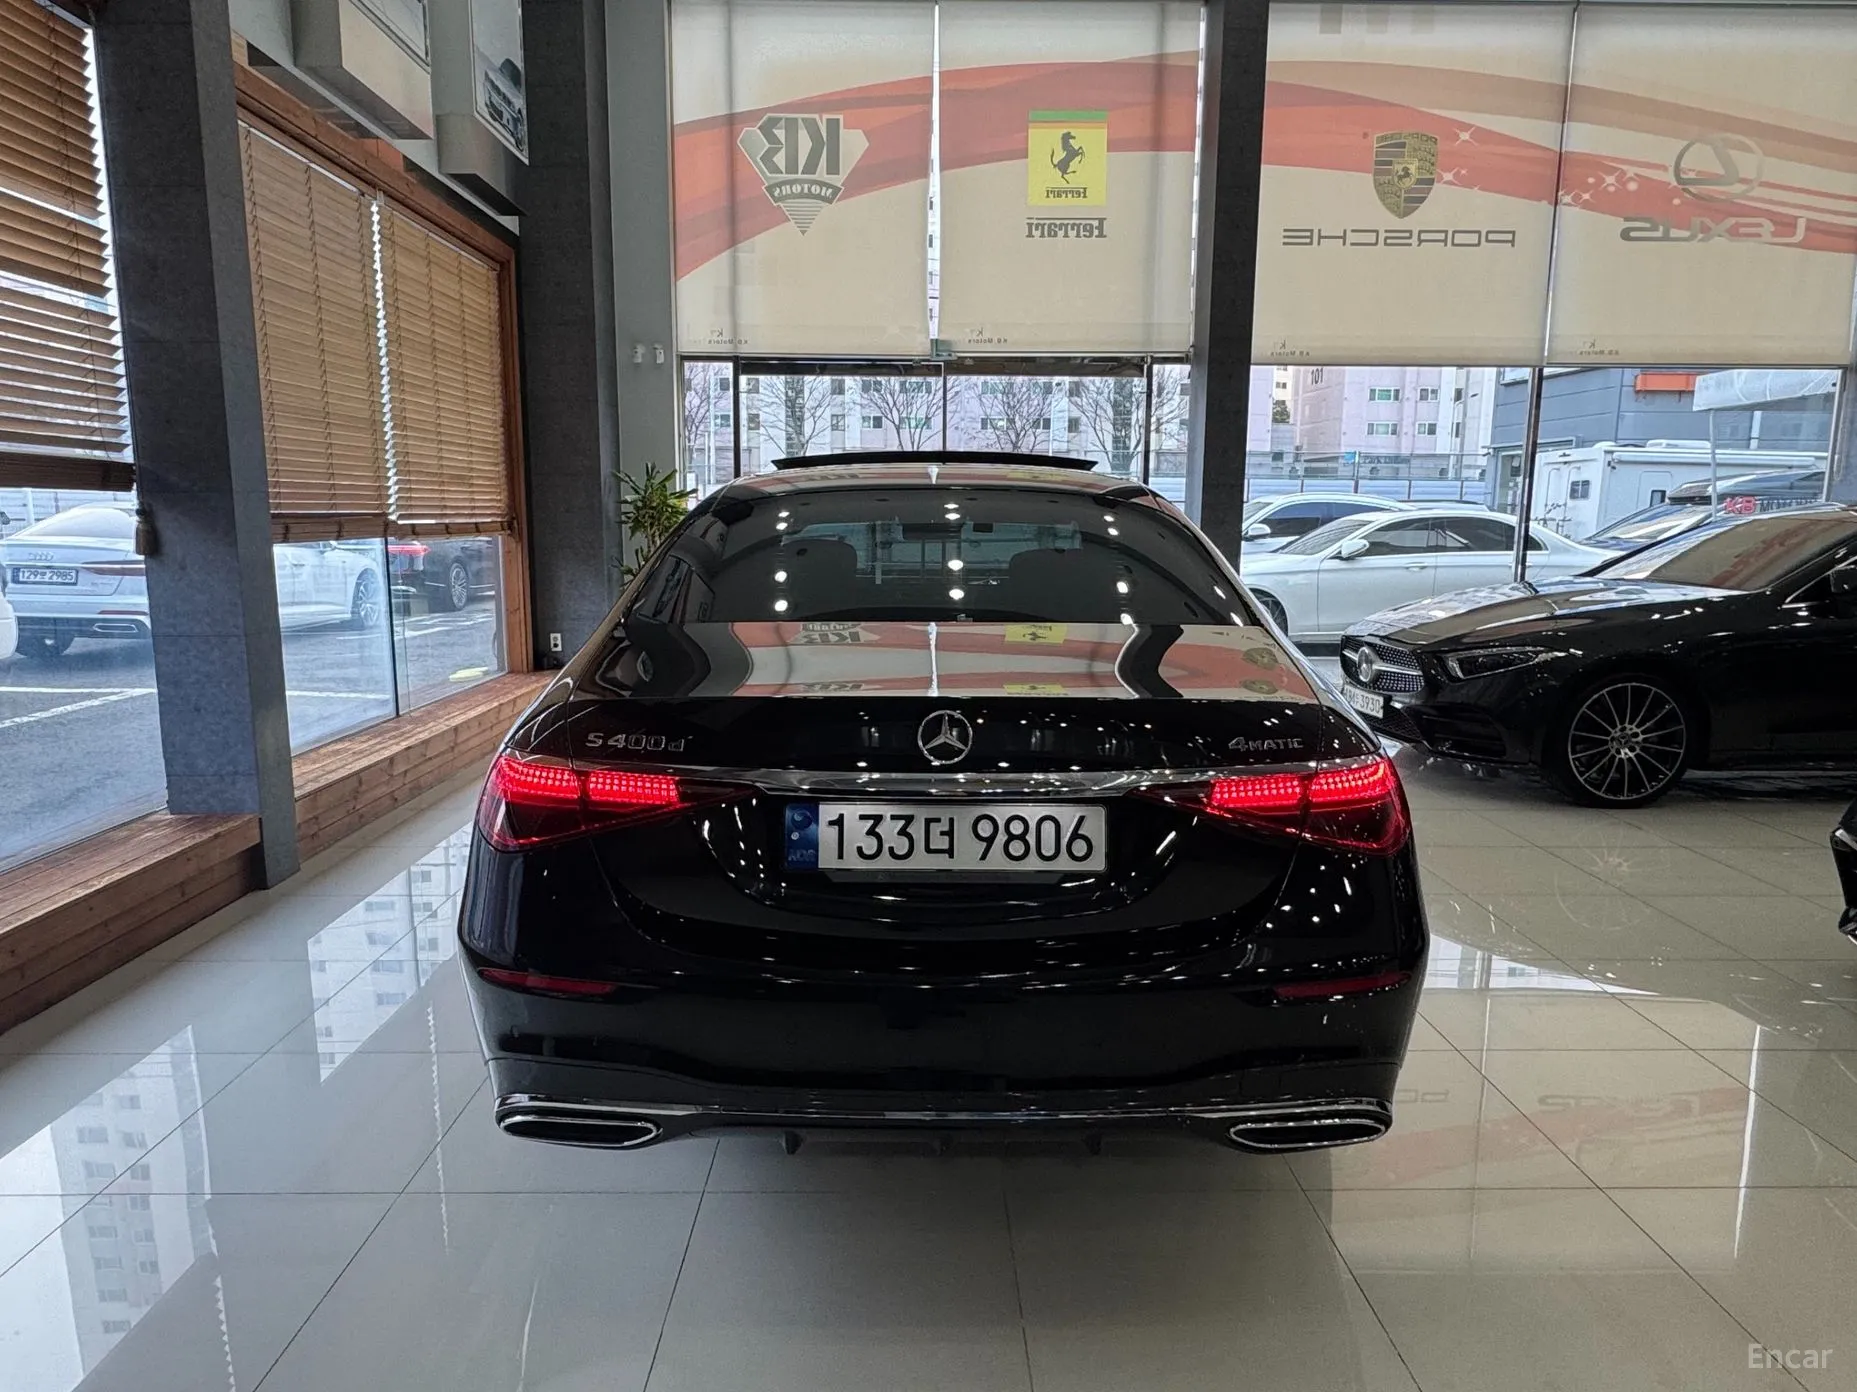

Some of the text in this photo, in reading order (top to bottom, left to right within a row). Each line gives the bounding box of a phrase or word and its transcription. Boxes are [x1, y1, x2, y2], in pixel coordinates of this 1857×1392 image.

[1310, 367, 1324, 386] 101
[48, 570, 74, 581] 2985
[1360, 694, 1381, 714] 3930
[1228, 736, 1304, 752] 4MATIC
[827, 812, 1094, 863] 133더 9806
